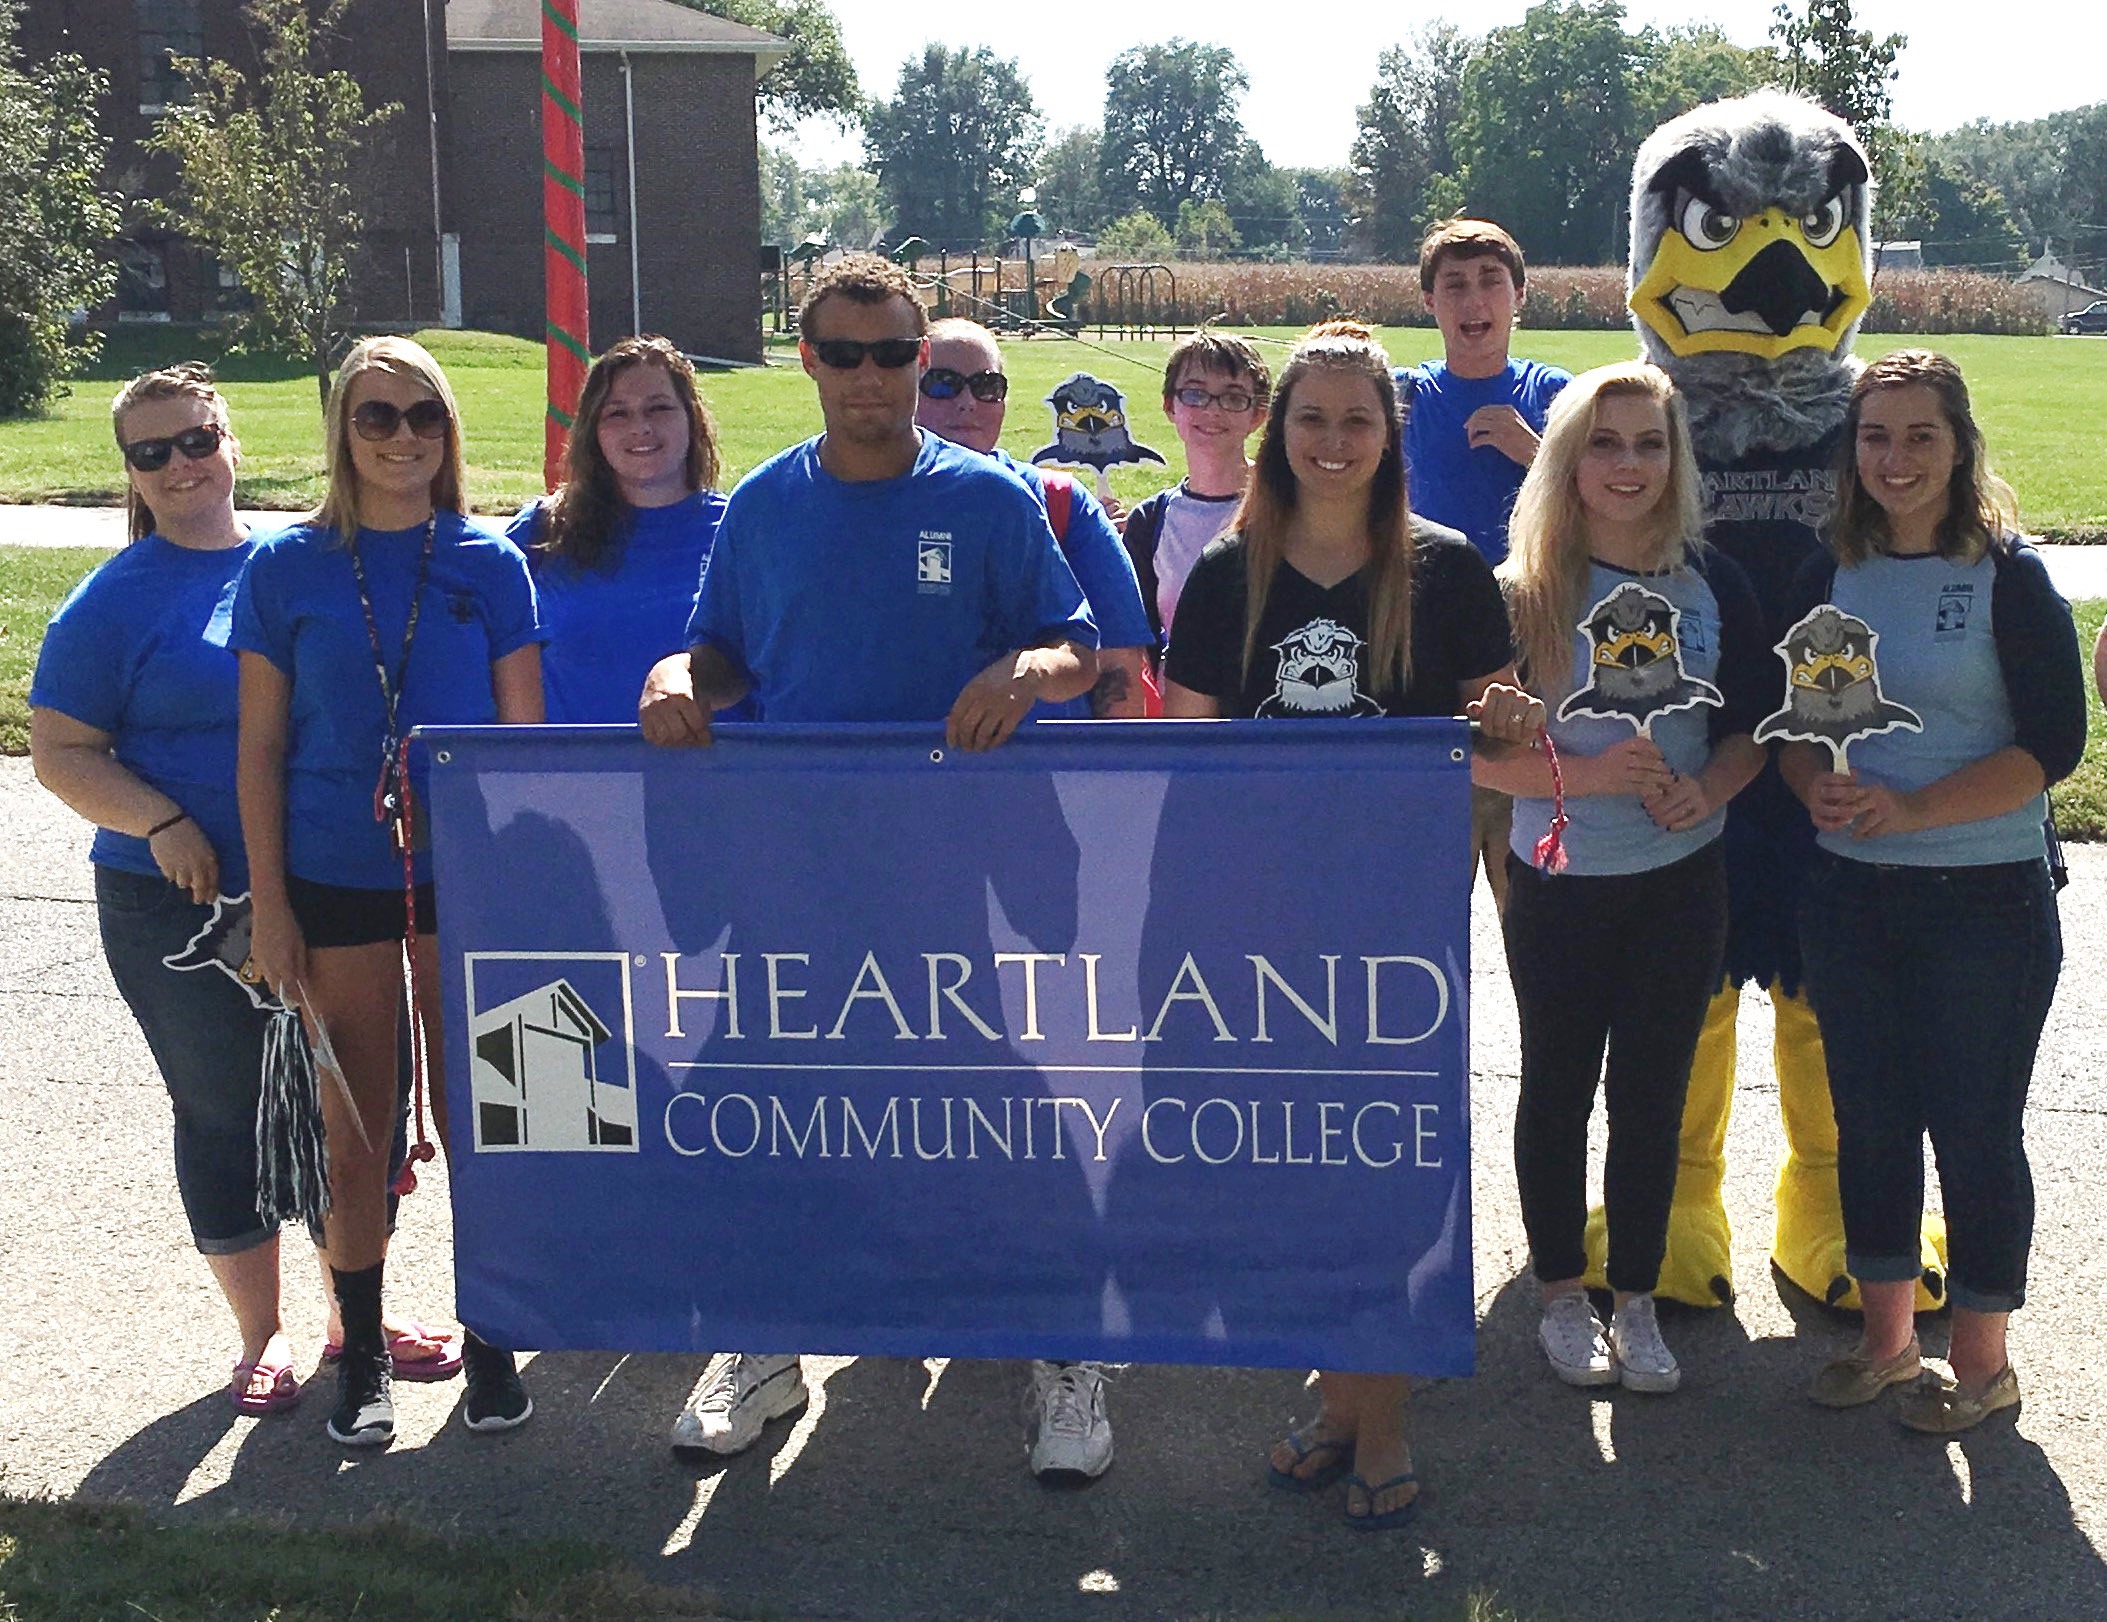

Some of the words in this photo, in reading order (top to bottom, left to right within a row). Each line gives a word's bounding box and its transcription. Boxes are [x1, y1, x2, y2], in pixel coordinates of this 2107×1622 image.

[1701, 468, 1838, 491] ARTLAN
[660, 949, 1450, 1046] HEARTLAND
[664, 1091, 1122, 1162] COMMUNITY
[1141, 1097, 1443, 1169] COLLEGE
